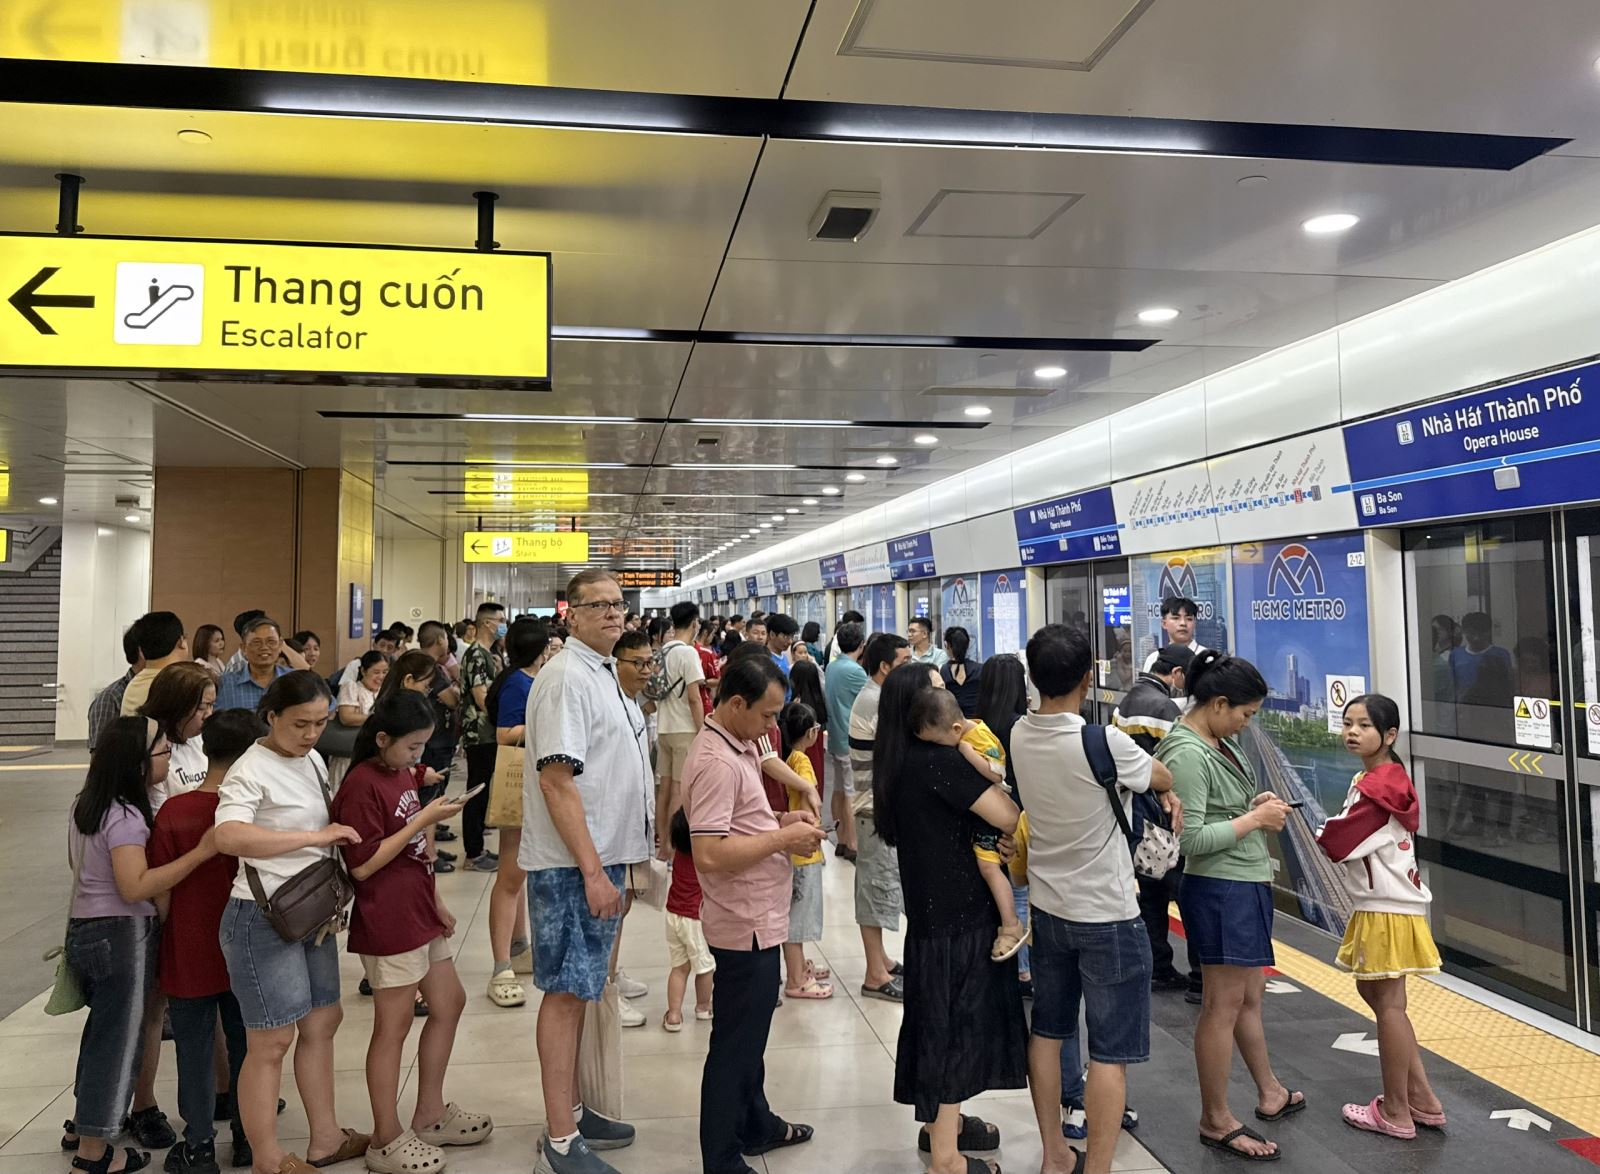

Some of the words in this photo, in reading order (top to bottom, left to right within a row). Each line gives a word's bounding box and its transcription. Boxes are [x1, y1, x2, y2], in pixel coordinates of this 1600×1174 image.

[224, 265, 362, 316] Thang
[379, 267, 483, 311] cuốn
[221, 320, 368, 350] Escalator
[1421, 412, 1453, 437] Nhà
[1455, 405, 1483, 430] Hát
[1484, 393, 1540, 423] Thành
[1543, 377, 1582, 411] Phố
[1463, 434, 1498, 453] Opera
[1500, 426, 1539, 444] House
[1055, 503, 1071, 516] Thành
[1070, 498, 1082, 513] Phố
[1377, 492, 1387, 503] Ba
[1387, 491, 1403, 502] Son
[1378, 506, 1386, 514] Ba
[1386, 506, 1397, 514] Son
[516, 537, 547, 548] Thang
[675, 574, 681, 584] 2
[1251, 599, 1290, 620] HCMC
[1293, 598, 1346, 620] METRO
